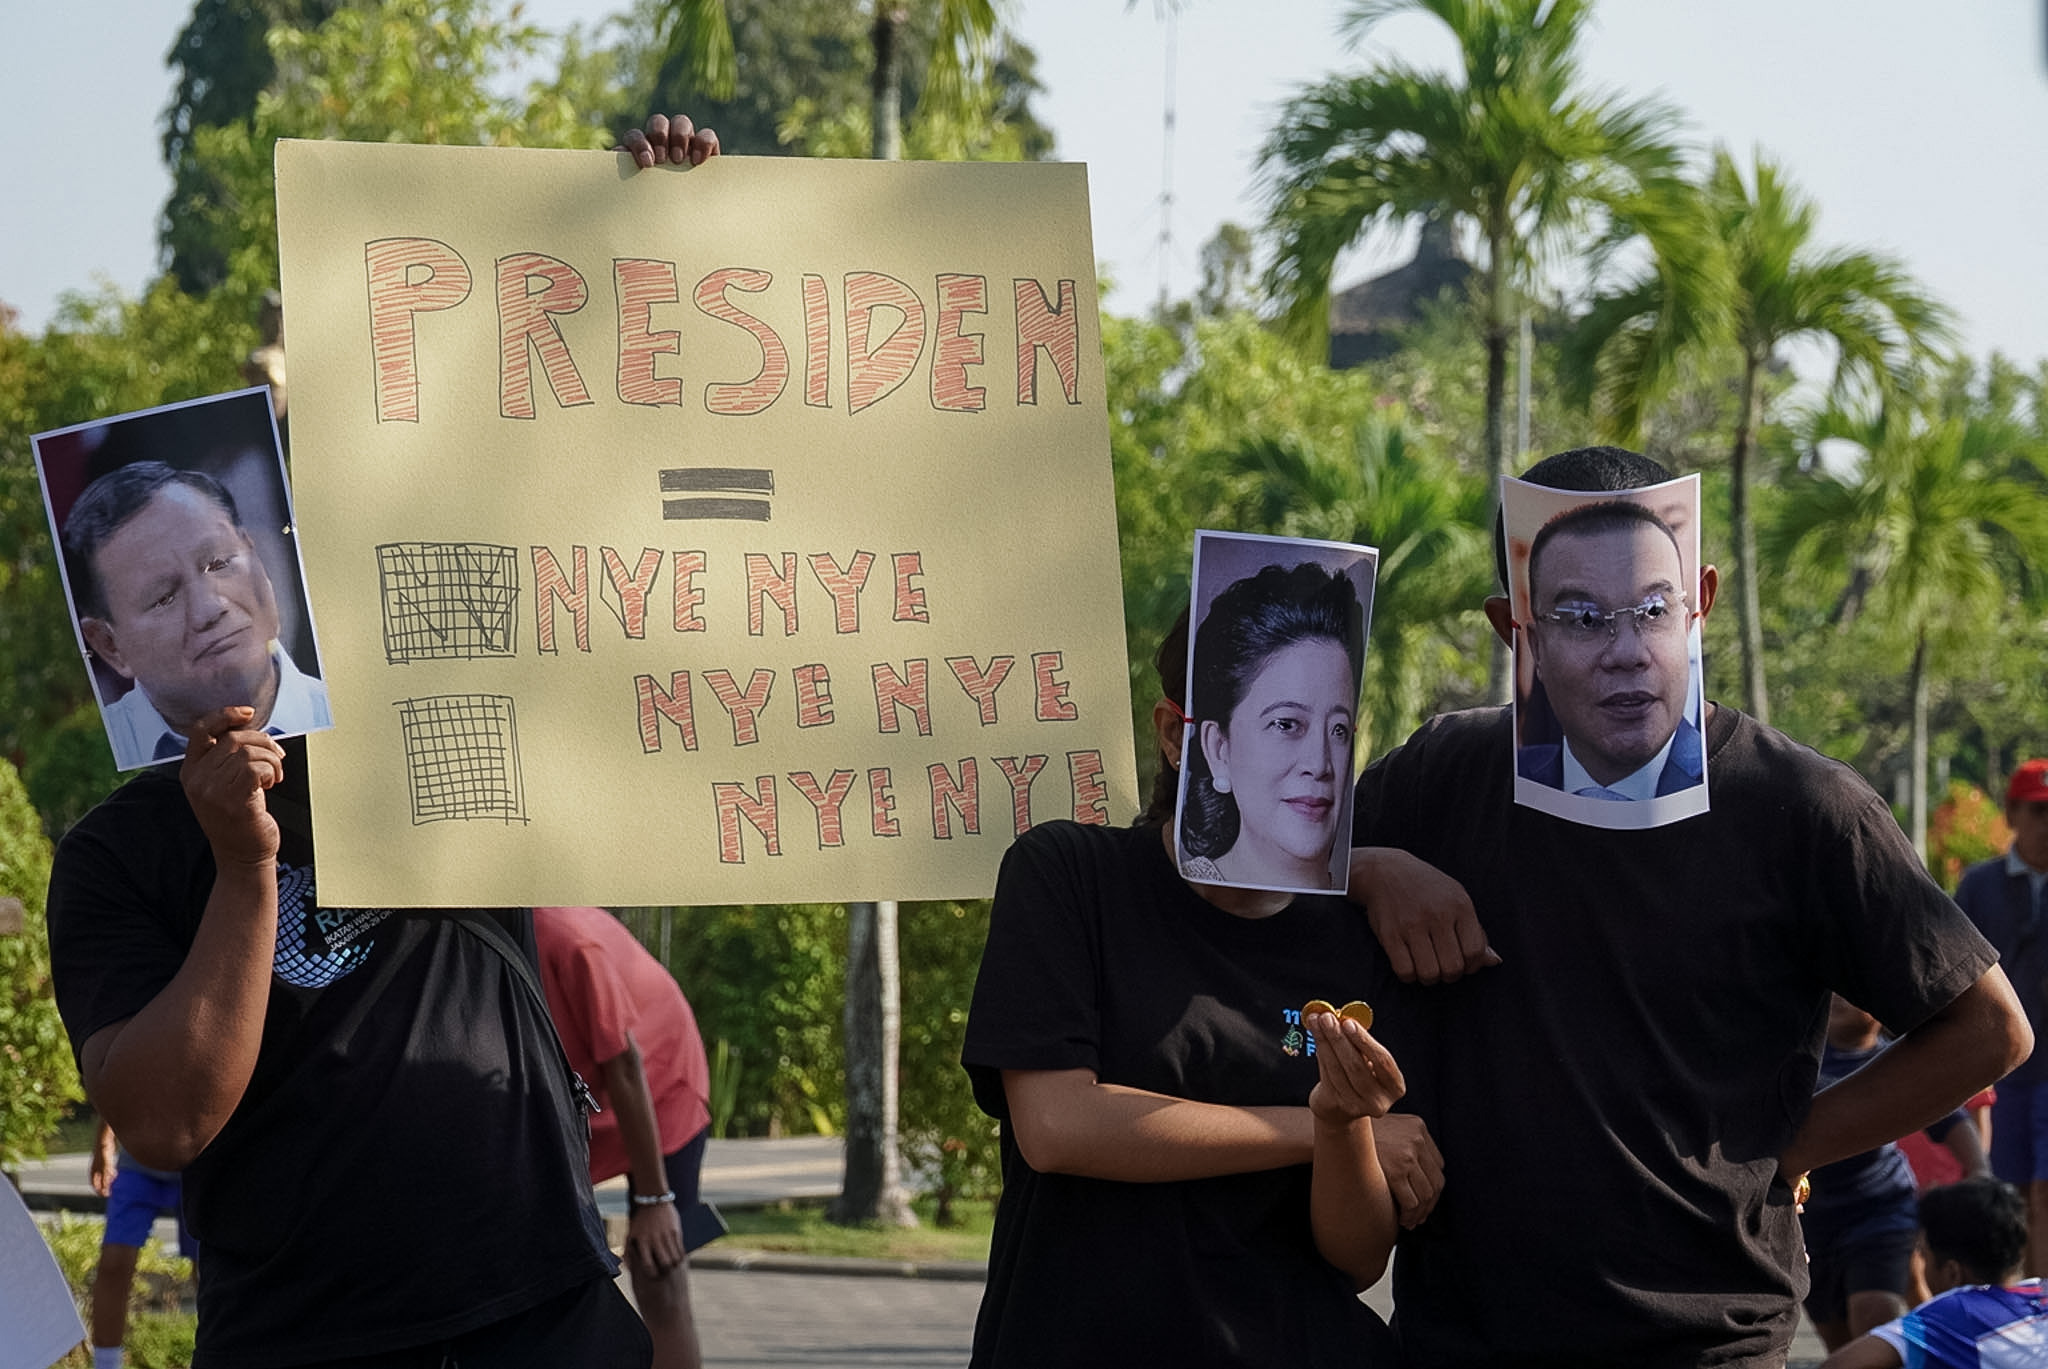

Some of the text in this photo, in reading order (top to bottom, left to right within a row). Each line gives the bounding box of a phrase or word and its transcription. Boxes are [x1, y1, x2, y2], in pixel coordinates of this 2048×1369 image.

[365, 237, 1081, 424] PRESIDEN
[531, 545, 929, 655] NYE NYE
[634, 651, 1078, 753] NYE NYE
[712, 750, 1110, 864] NYE NYE
